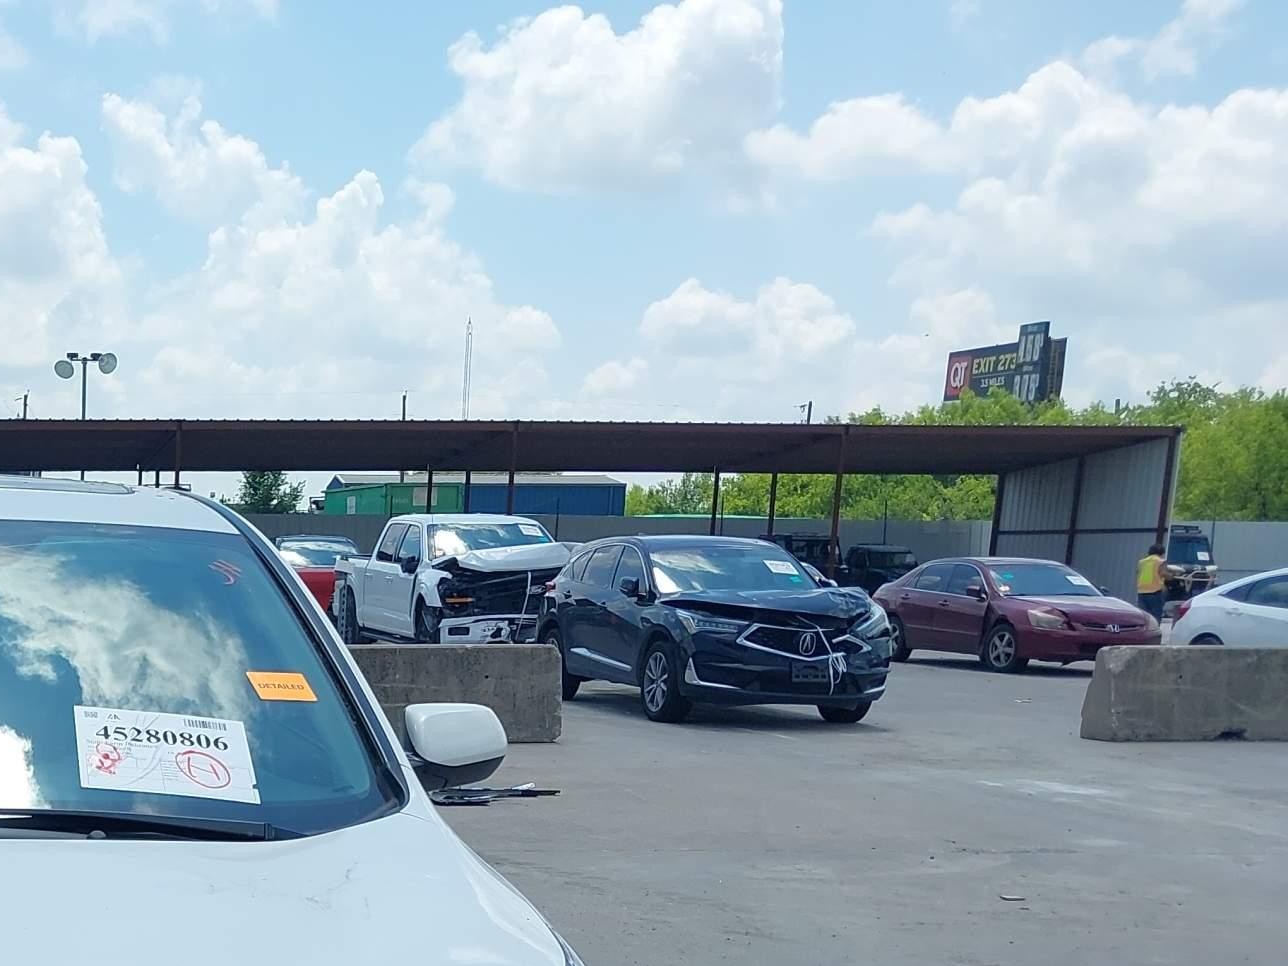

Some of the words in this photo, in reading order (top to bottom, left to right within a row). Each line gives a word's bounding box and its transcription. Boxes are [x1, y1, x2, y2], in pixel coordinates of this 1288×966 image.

[950, 362, 967, 389] QT
[972, 356, 995, 375] EXIT
[998, 352, 1017, 371] 273
[96, 725, 229, 751] 45280806
